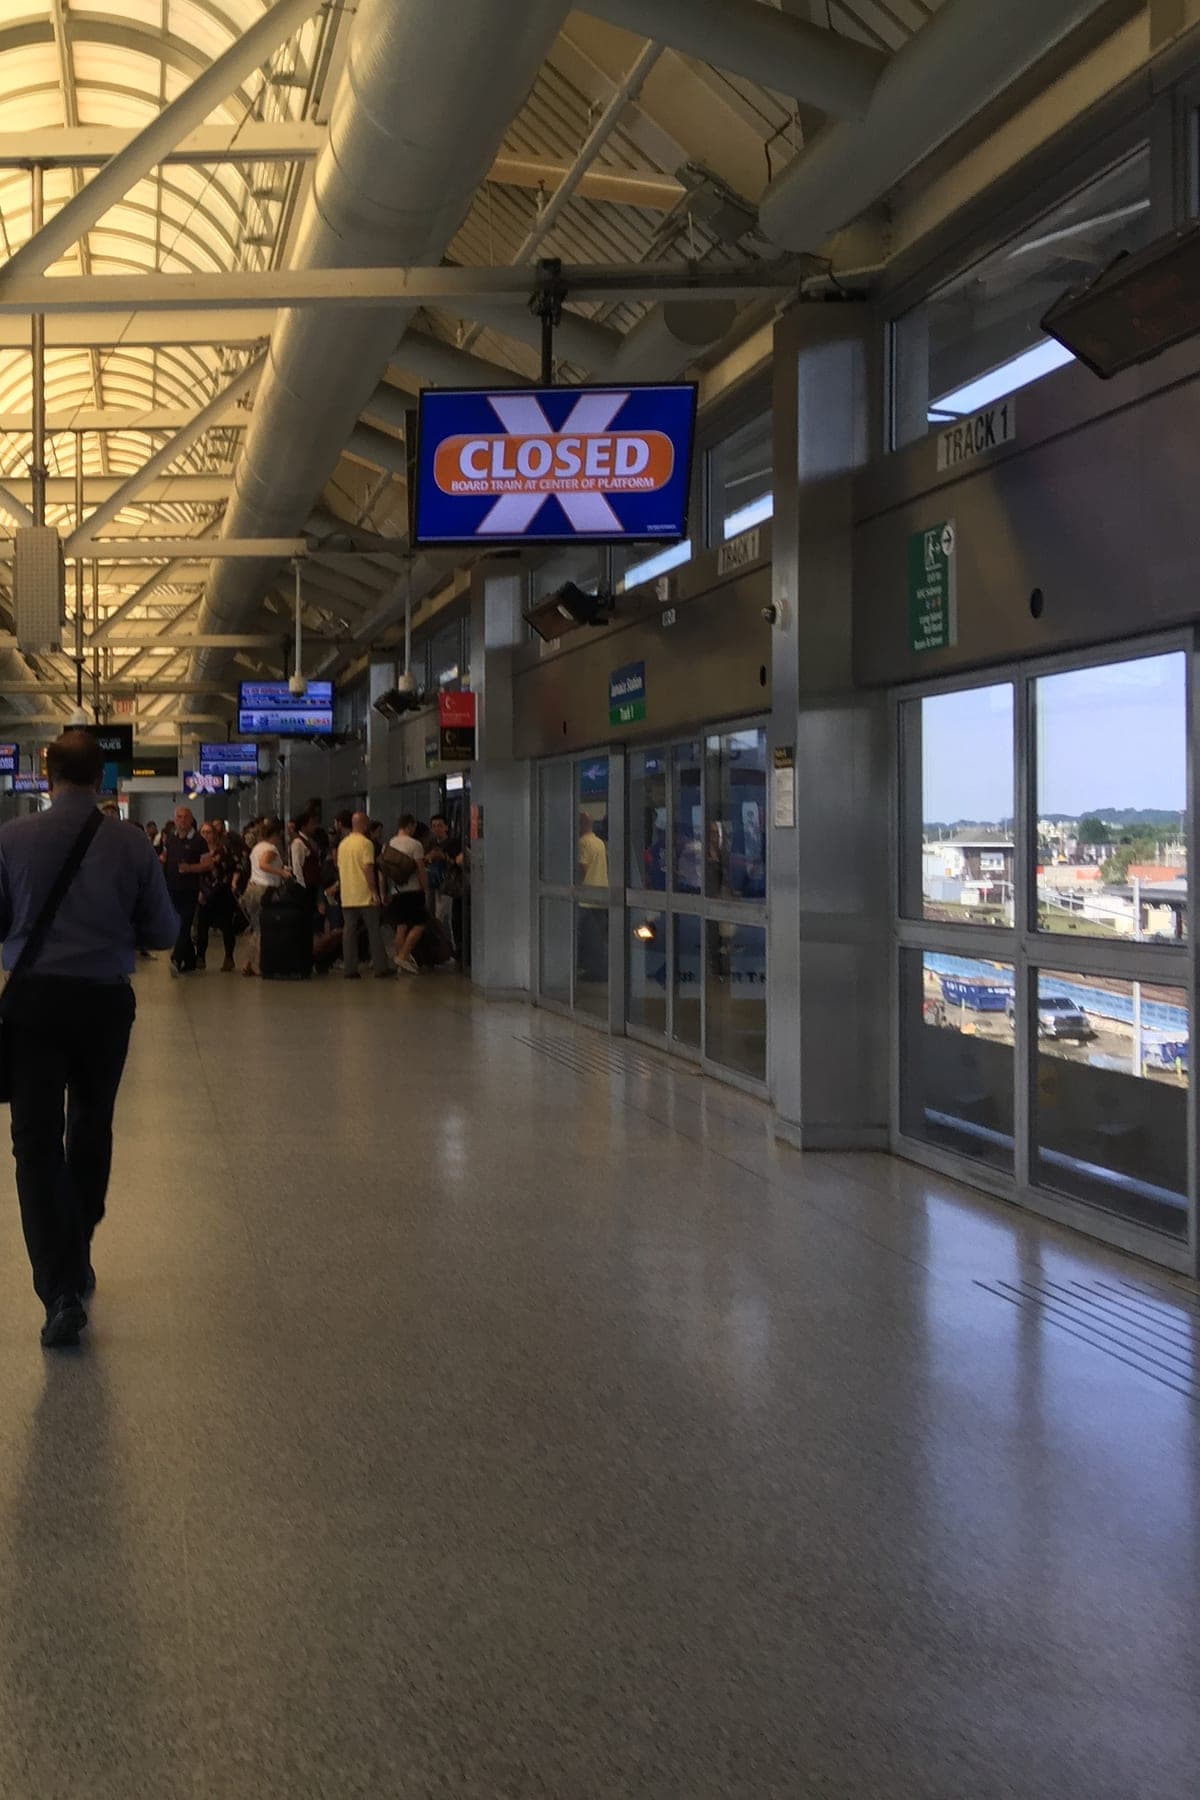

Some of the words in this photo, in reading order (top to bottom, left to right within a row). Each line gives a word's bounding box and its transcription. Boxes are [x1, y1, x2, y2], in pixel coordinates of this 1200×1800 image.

[944, 410, 996, 465] TRACK
[1001, 405, 1008, 439] 1
[459, 437, 650, 479] CLOSED
[451, 480, 488, 492] BOARD
[490, 479, 523, 491] TRAIN
[524, 479, 538, 490] AT
[539, 478, 579, 490] CENTER
[580, 478, 596, 489] OF
[598, 476, 654, 489] PLATFORM
